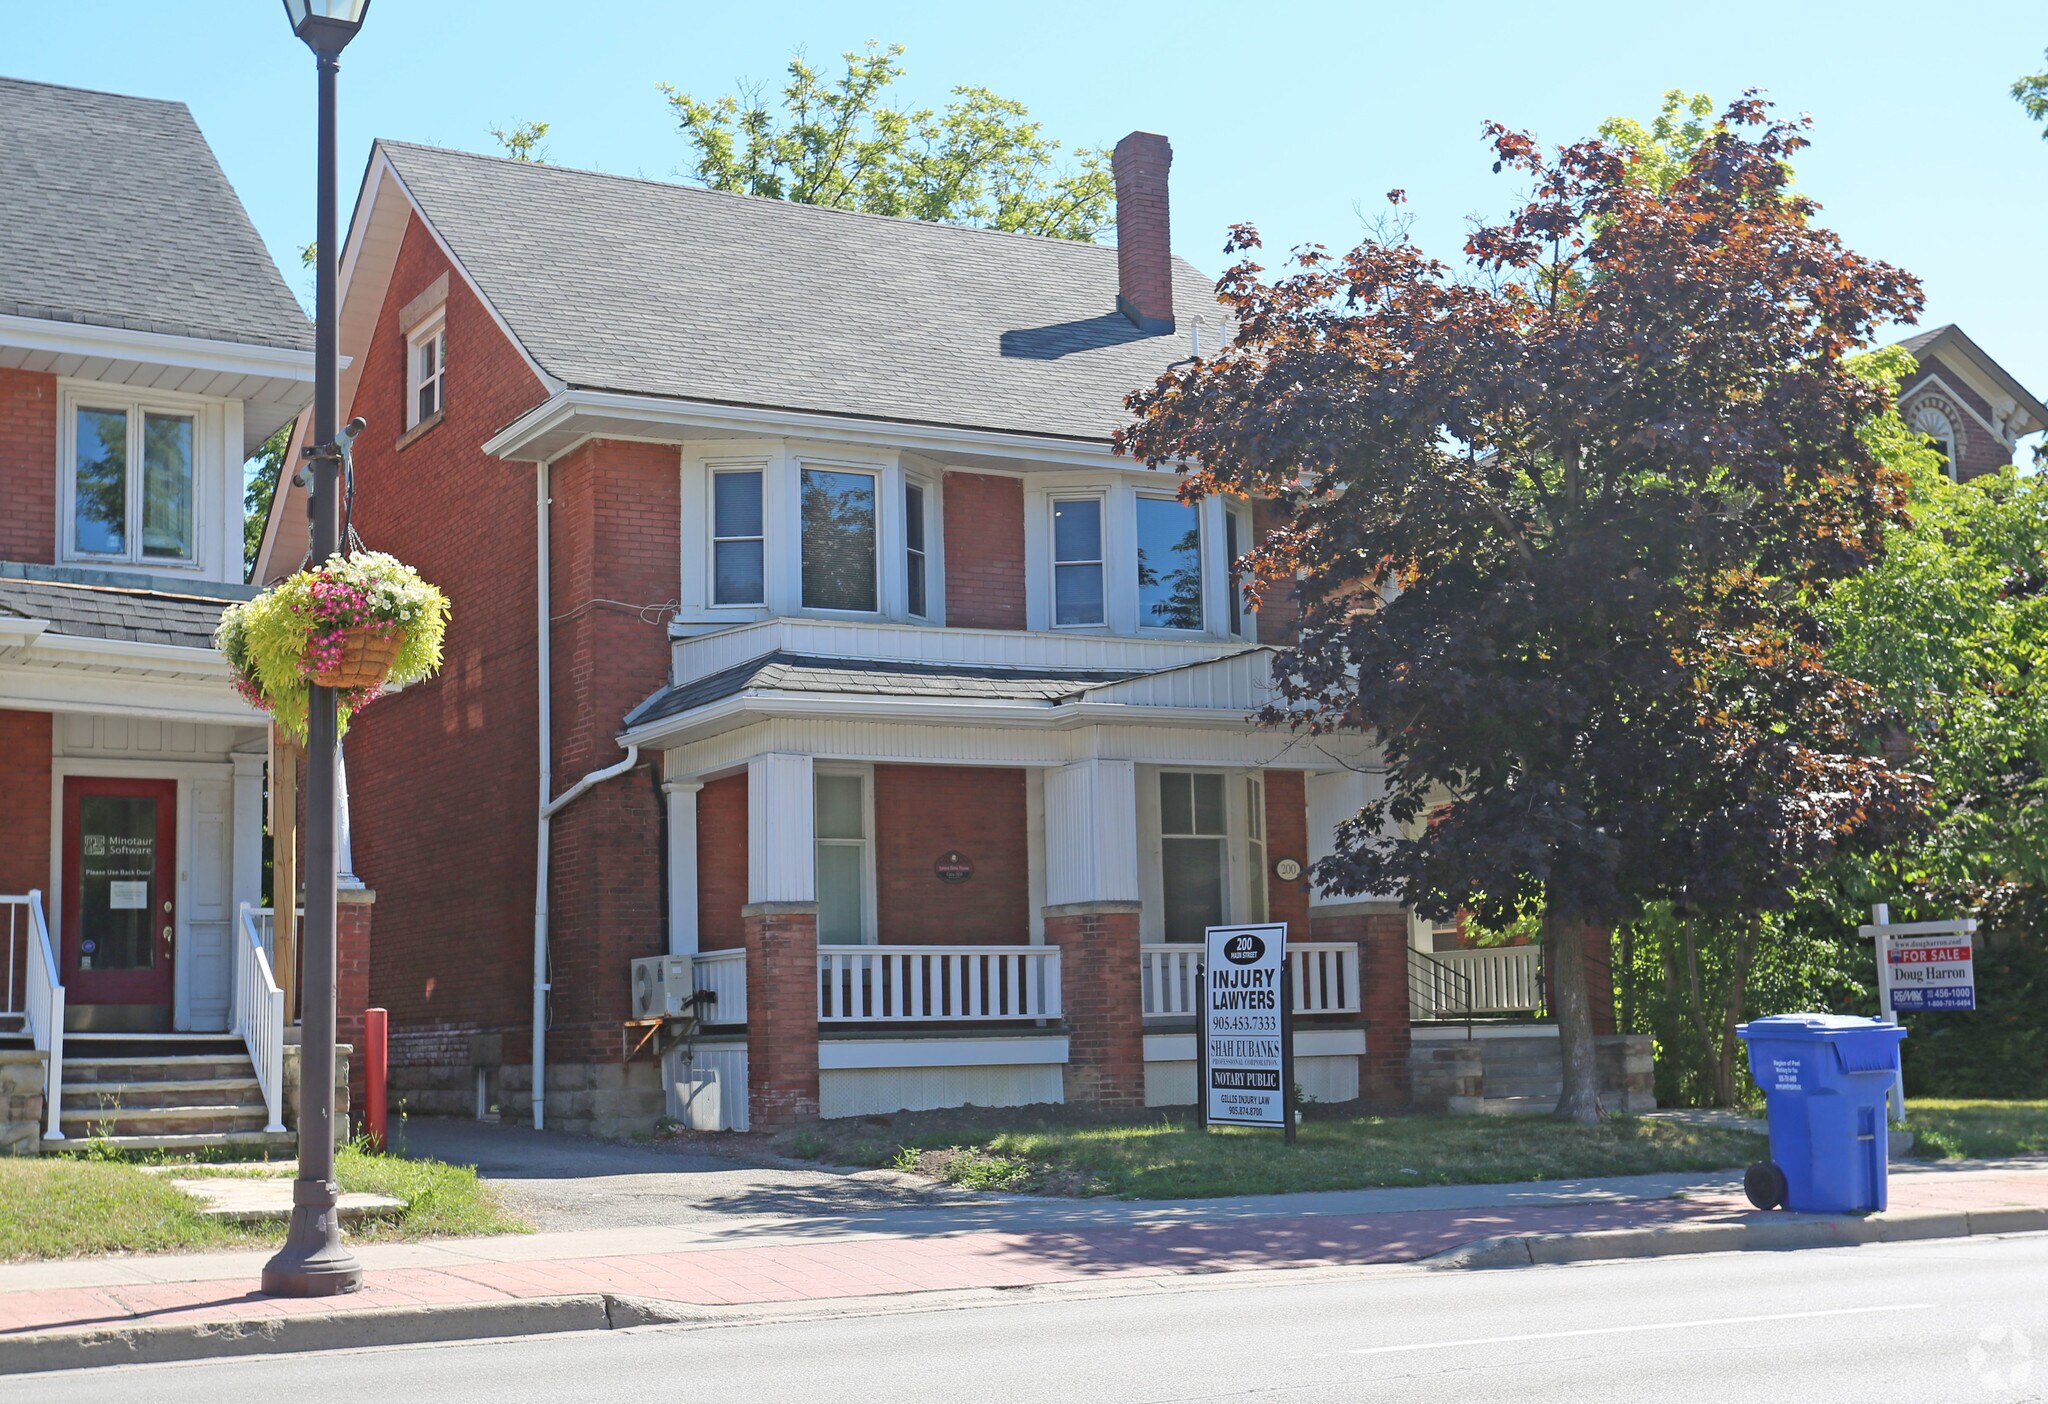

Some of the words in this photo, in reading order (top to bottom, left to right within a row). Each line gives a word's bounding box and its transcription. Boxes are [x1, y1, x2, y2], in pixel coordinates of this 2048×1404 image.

[109, 836, 153, 845] Minotaur
[109, 845, 152, 855] Software
[1281, 863, 1296, 875] 200
[1236, 937, 1253, 951] 200
[1242, 951, 1258, 959] STREET
[1903, 950, 1927, 962] FOR
[1931, 949, 1960, 961] SALE
[1213, 969, 1275, 989] INJURY
[1894, 967, 1924, 983] Doug
[1926, 966, 1966, 980] Harron
[1213, 990, 1275, 1010] LAWYERS
[1893, 989, 1924, 1002] RE/MAX
[1934, 988, 1970, 998] 456-1000
[1213, 1016, 1276, 1031] 905.453.7333
[1211, 1040, 1234, 1057] SHAH
[1236, 1040, 1280, 1058] EUBANKS
[1214, 1071, 1245, 1086] NOTARY
[1246, 1073, 1277, 1087] PUBLIC
[1221, 1094, 1238, 1103] GILLIS
[1238, 1095, 1257, 1104] INJURY
[1258, 1096, 1271, 1105] LAW
[1228, 1106, 1263, 1116] 905.874.8700
